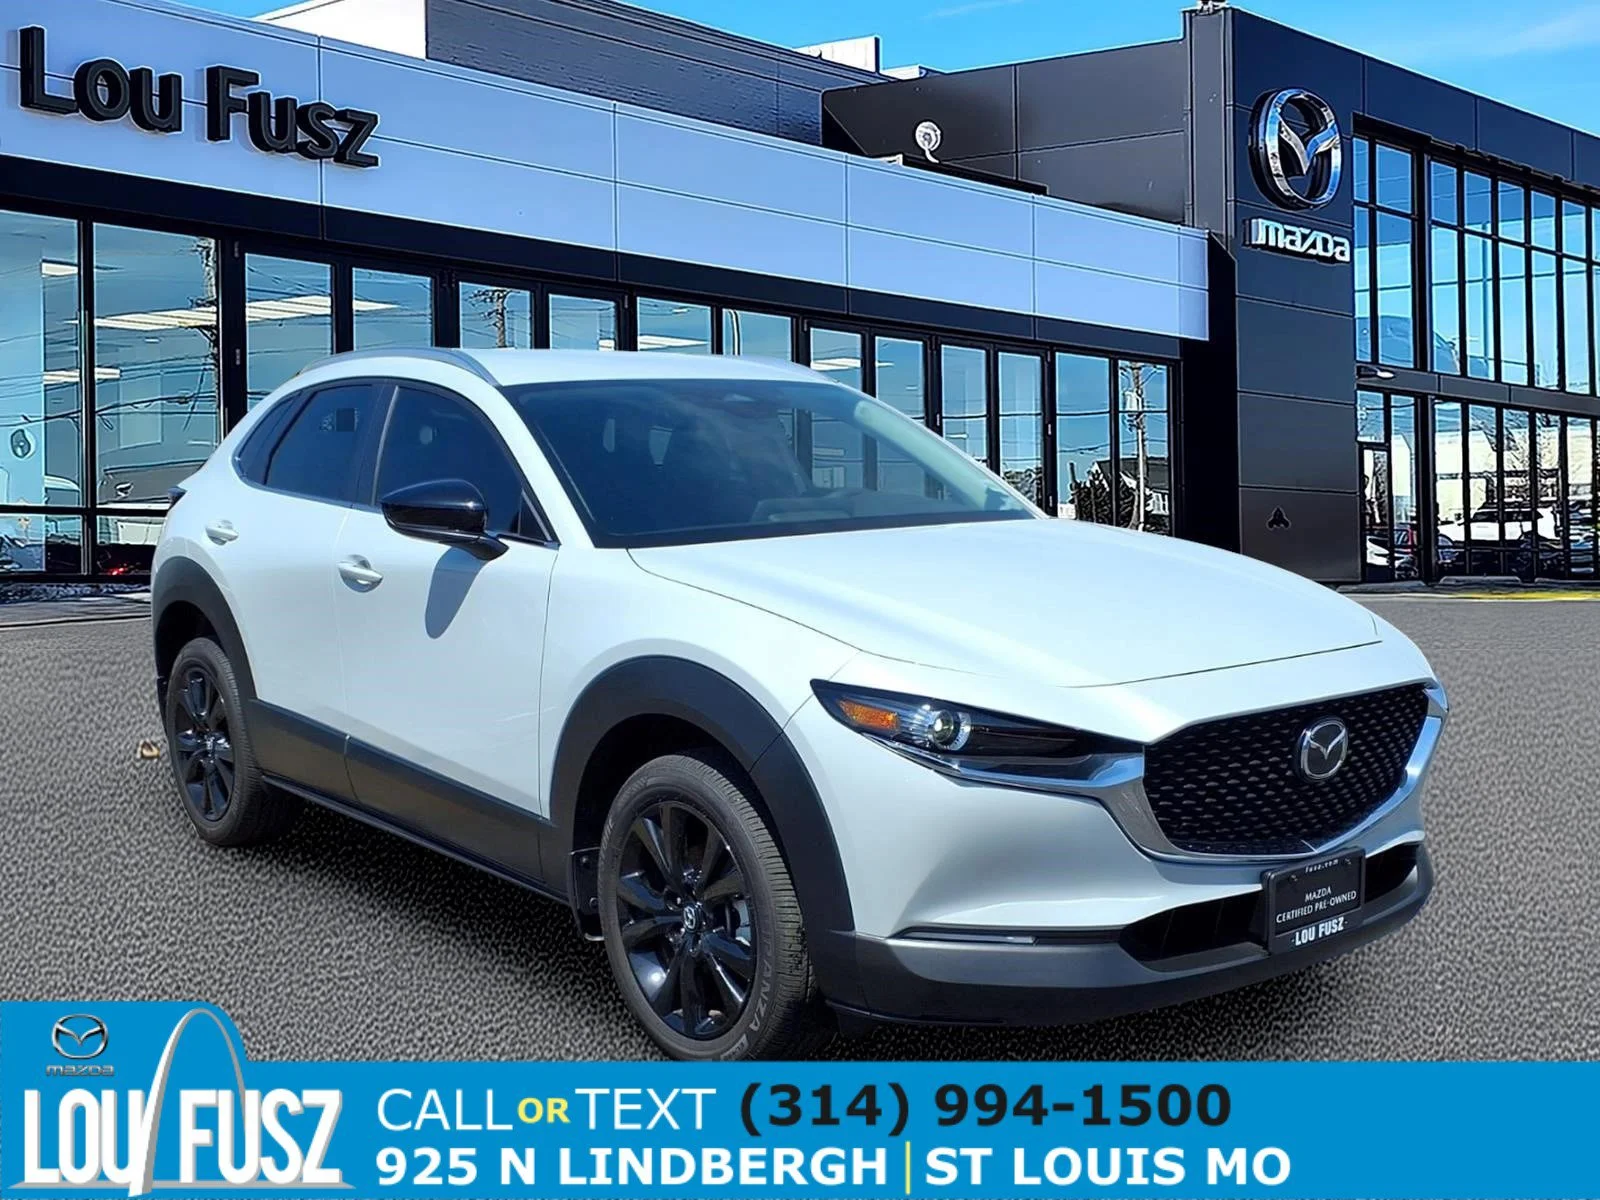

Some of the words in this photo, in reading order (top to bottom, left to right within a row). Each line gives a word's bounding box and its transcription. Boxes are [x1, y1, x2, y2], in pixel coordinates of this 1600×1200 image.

[19, 26, 182, 133] Lou
[206, 66, 379, 166] Fusz
[1276, 904, 1313, 923] CERTIFIED
[1314, 890, 1357, 912] PRE-OWNED
[1304, 886, 1332, 902] MAZDA
[1295, 927, 1316, 946] LOU
[1318, 916, 1345, 938] FUSZ
